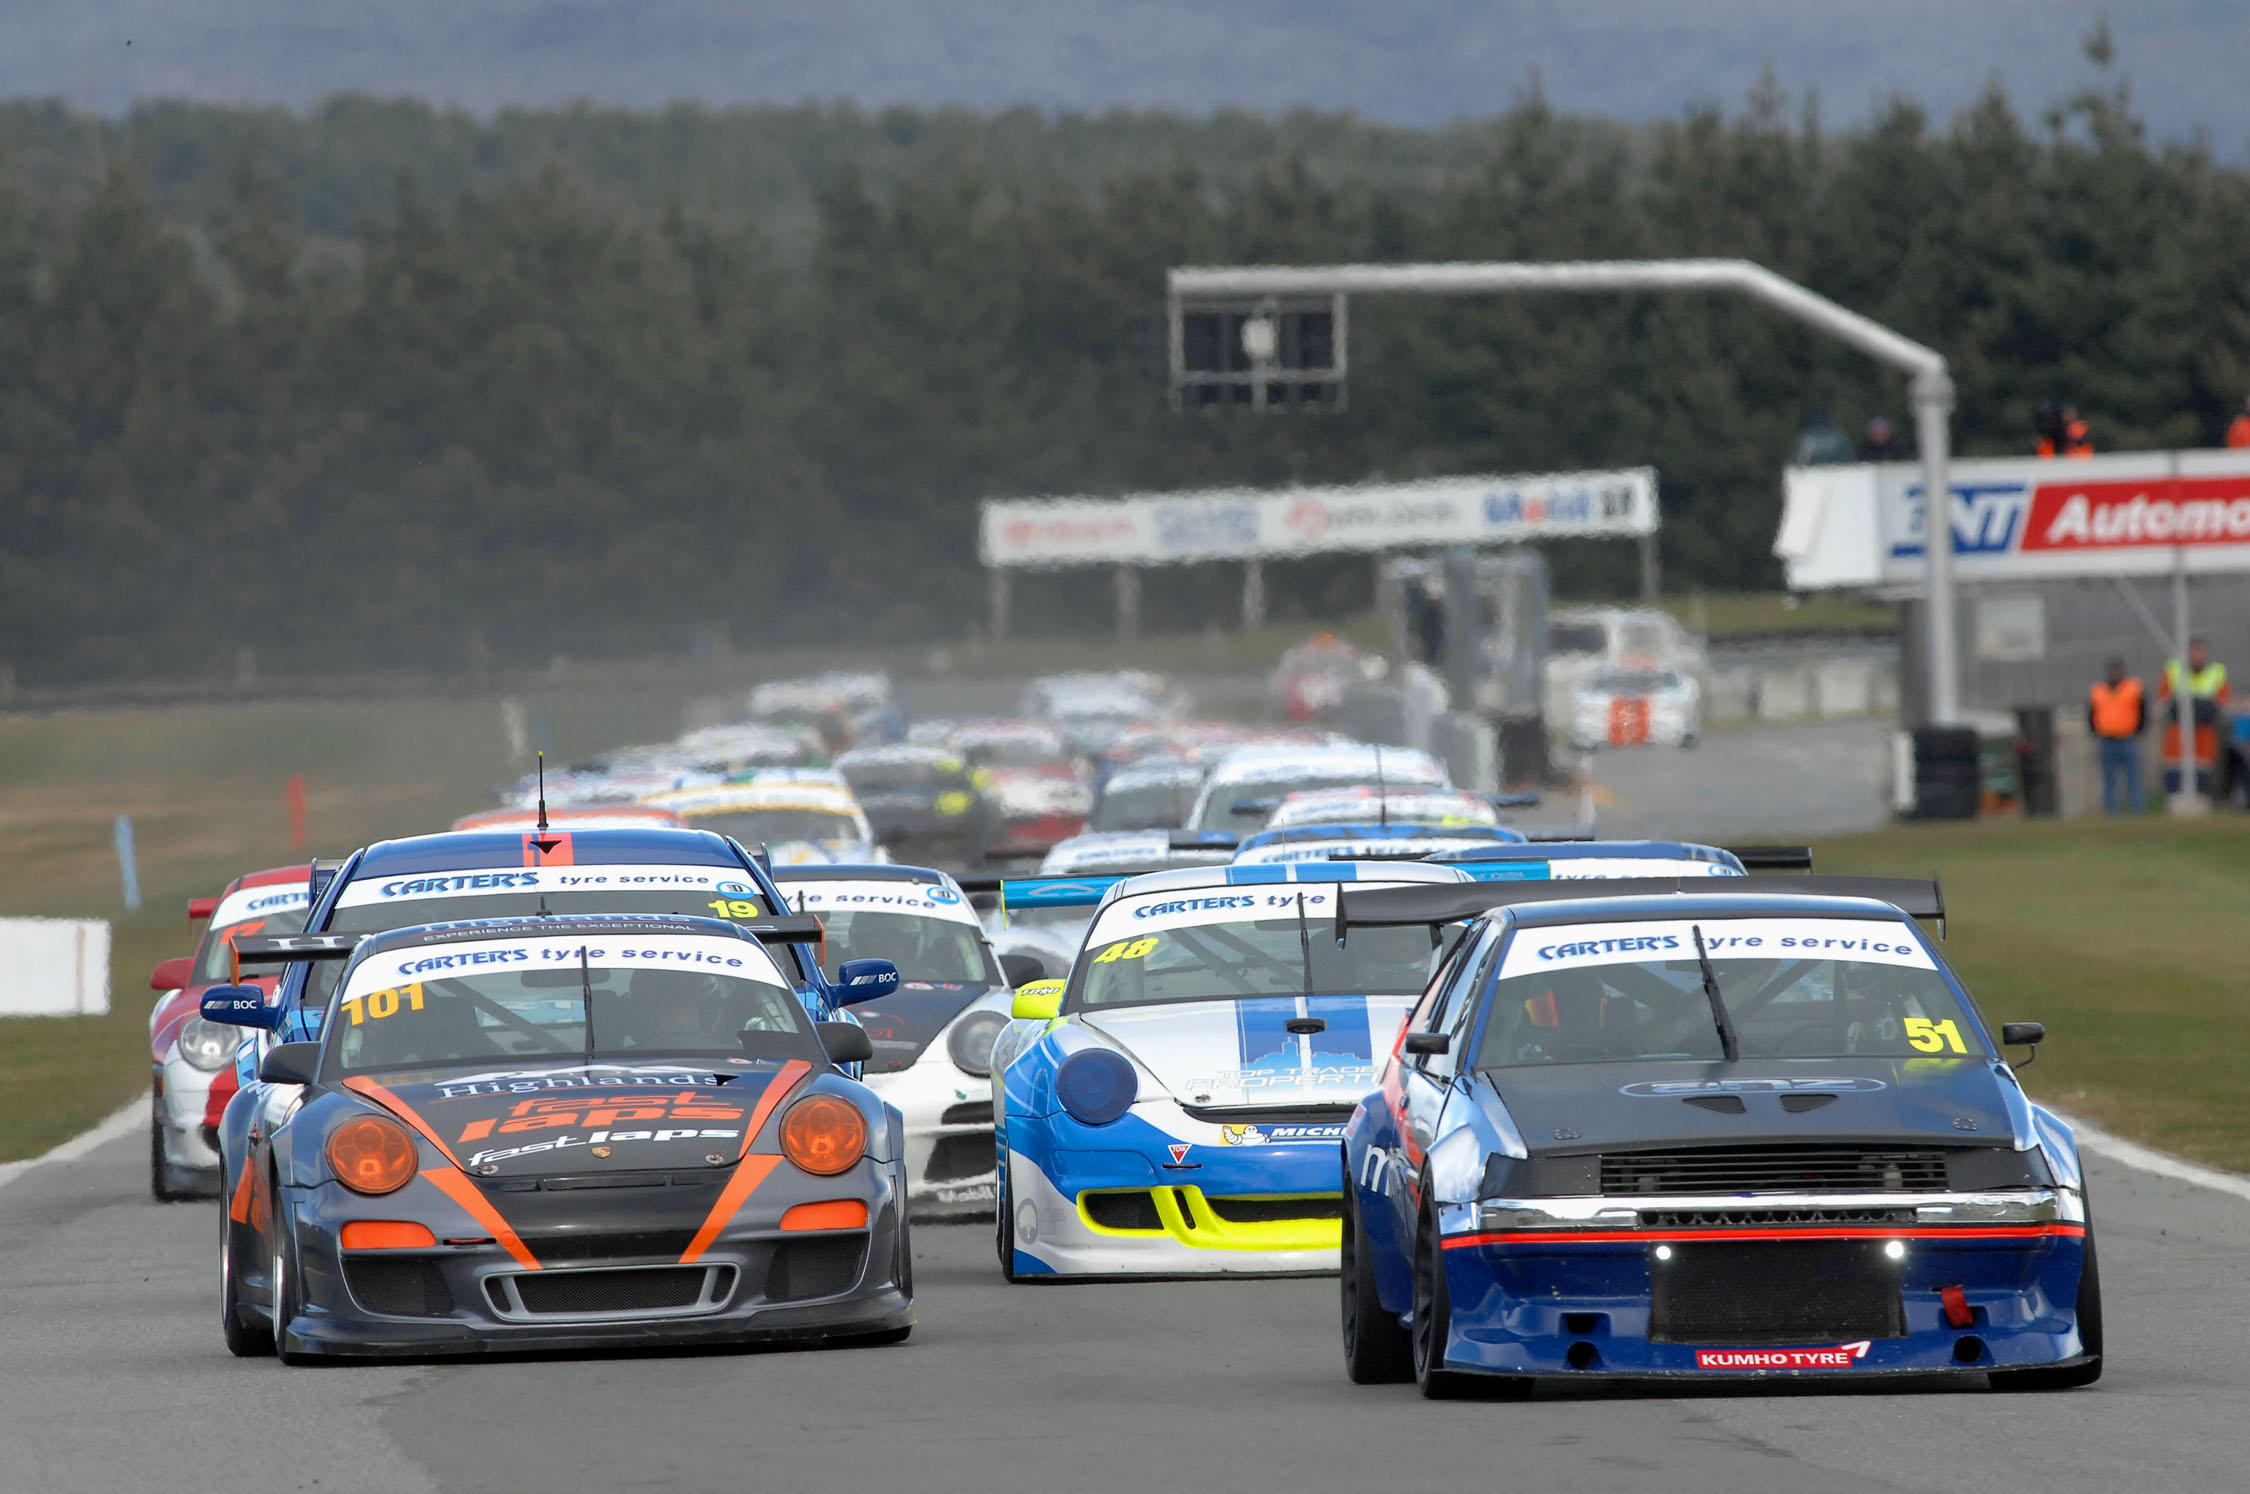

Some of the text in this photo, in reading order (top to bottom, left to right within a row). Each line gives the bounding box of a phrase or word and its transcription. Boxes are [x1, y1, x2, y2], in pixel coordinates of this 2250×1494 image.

[380, 872, 709, 897] CARTER'S tyre service
[707, 900, 759, 918] 19
[835, 893, 936, 909] service
[1132, 894, 1326, 919] CARTER'S tyre
[423, 925, 533, 942] EXPERIENCE
[576, 923, 695, 931] EXCEPTIONAL
[1093, 937, 1159, 964] 48
[1538, 935, 1680, 961] CARTER'S
[1781, 935, 1913, 956] service
[398, 947, 743, 976] CARTER'S tyre service
[878, 972, 897, 983] BOC
[233, 1001, 257, 1010] BOC
[341, 982, 425, 1026] 101
[1903, 1017, 1968, 1055] 51
[439, 1074, 728, 1099] Highlands
[508, 1092, 731, 1118] fast
[457, 1108, 745, 1144] laps
[1271, 1128, 1347, 1136] MICH
[1702, 1353, 1848, 1365] KUMHO TYRE
